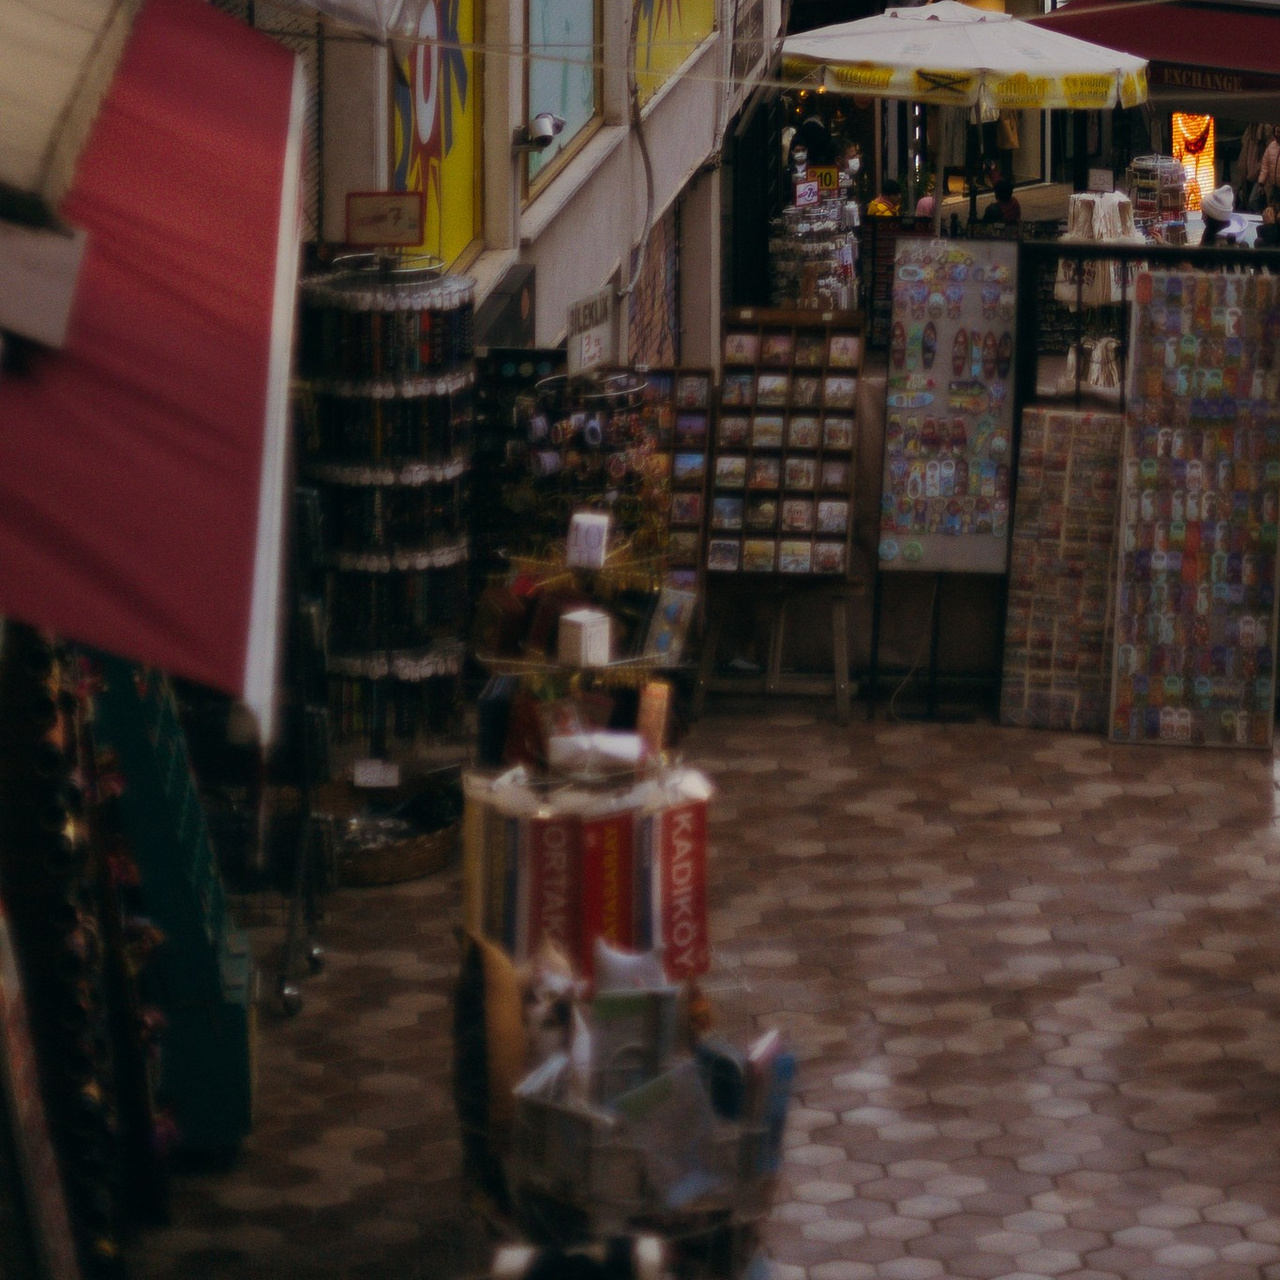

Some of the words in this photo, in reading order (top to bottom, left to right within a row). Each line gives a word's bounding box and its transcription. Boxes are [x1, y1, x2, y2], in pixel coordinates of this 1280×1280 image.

[1163, 67, 1243, 91] EXCHANGE
[818, 172, 832, 187] 10
[671, 812, 697, 969] KADIKÖY
